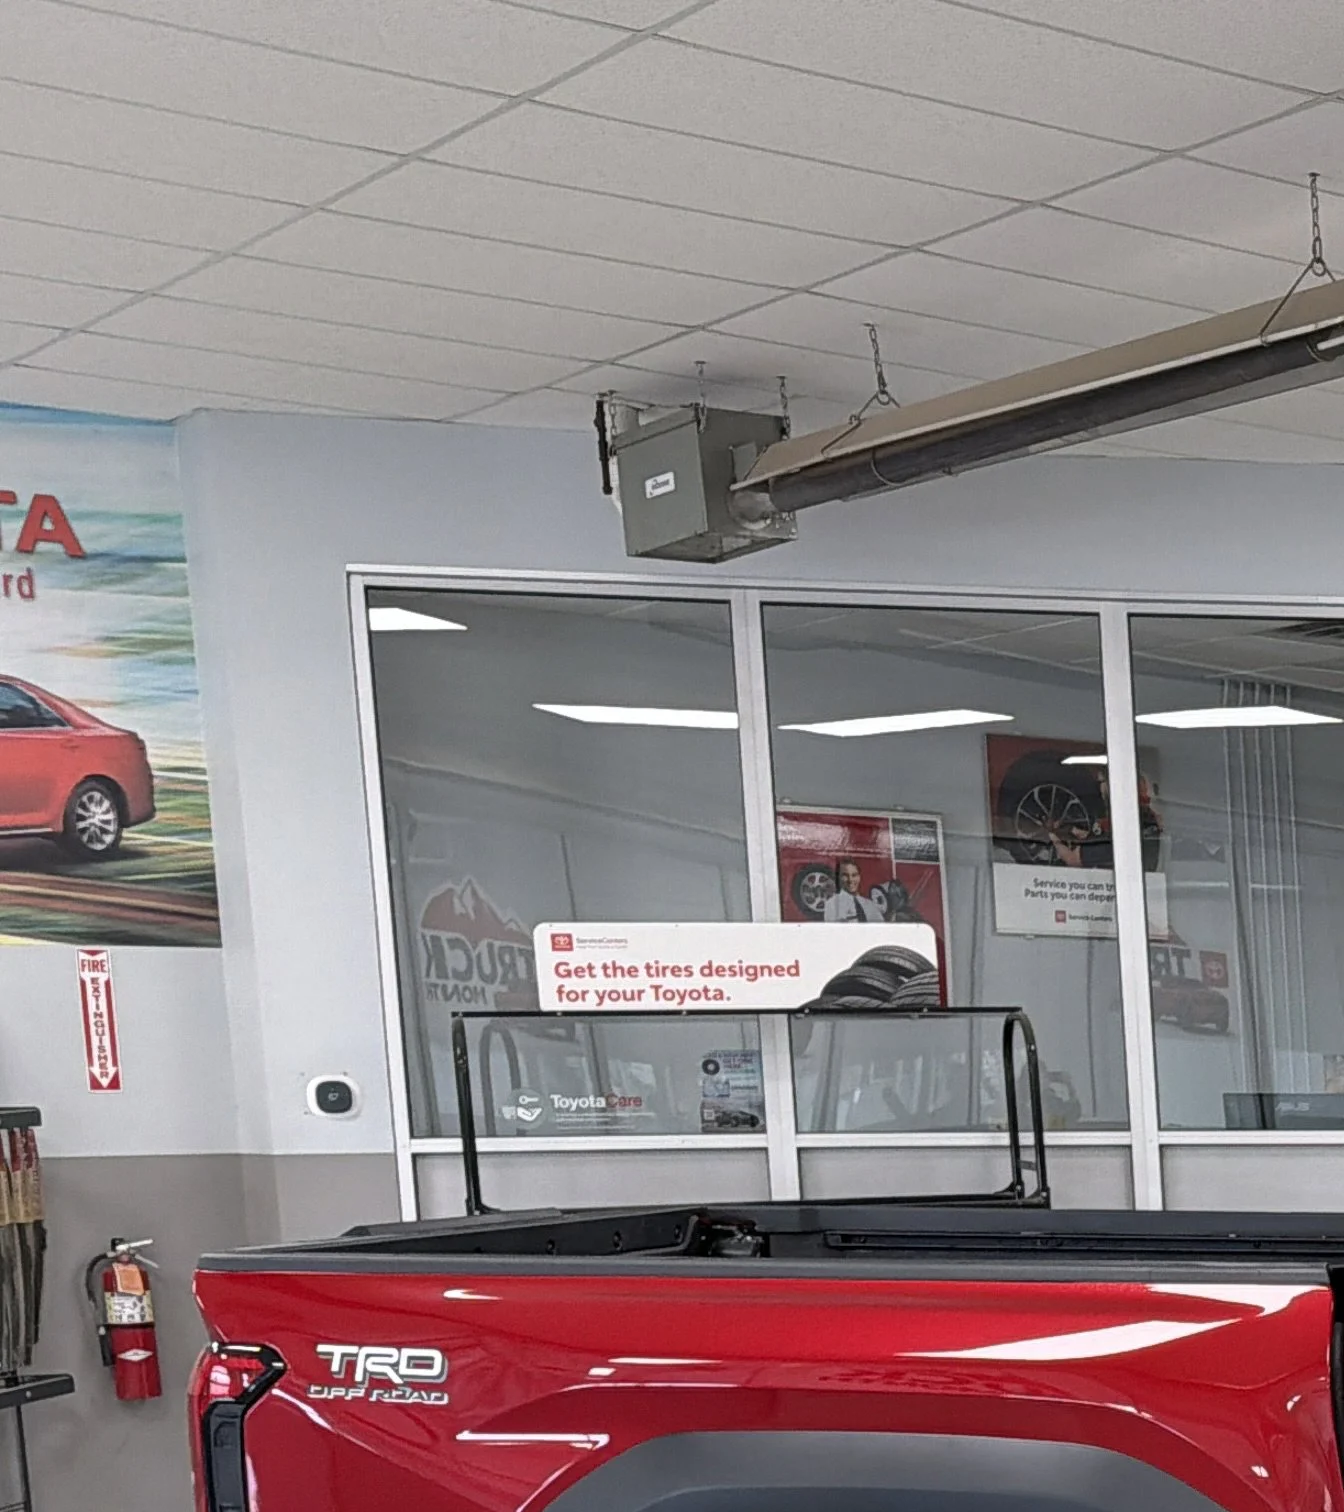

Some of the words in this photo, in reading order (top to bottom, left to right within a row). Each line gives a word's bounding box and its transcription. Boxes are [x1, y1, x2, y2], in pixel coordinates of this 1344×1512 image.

[1024, 888, 1048, 898] Parts
[1050, 891, 1067, 900] you
[1033, 878, 1066, 888] Service
[1068, 882, 1086, 891] you
[1087, 883, 1104, 891] can
[80, 959, 108, 973] FIRE
[554, 961, 597, 979] Get
[601, 961, 639, 979] the
[644, 960, 694, 979] tires
[699, 960, 801, 982] designed
[556, 984, 590, 1003] for
[594, 988, 645, 1006] your
[650, 985, 731, 1006] Toyota.
[90, 977, 109, 1079] EXTINGUISHER
[550, 1093, 643, 1111] ToyotaCare
[316, 1344, 448, 1386] TRD
[307, 1384, 366, 1400] OFF
[369, 1387, 450, 1405] ROAD
